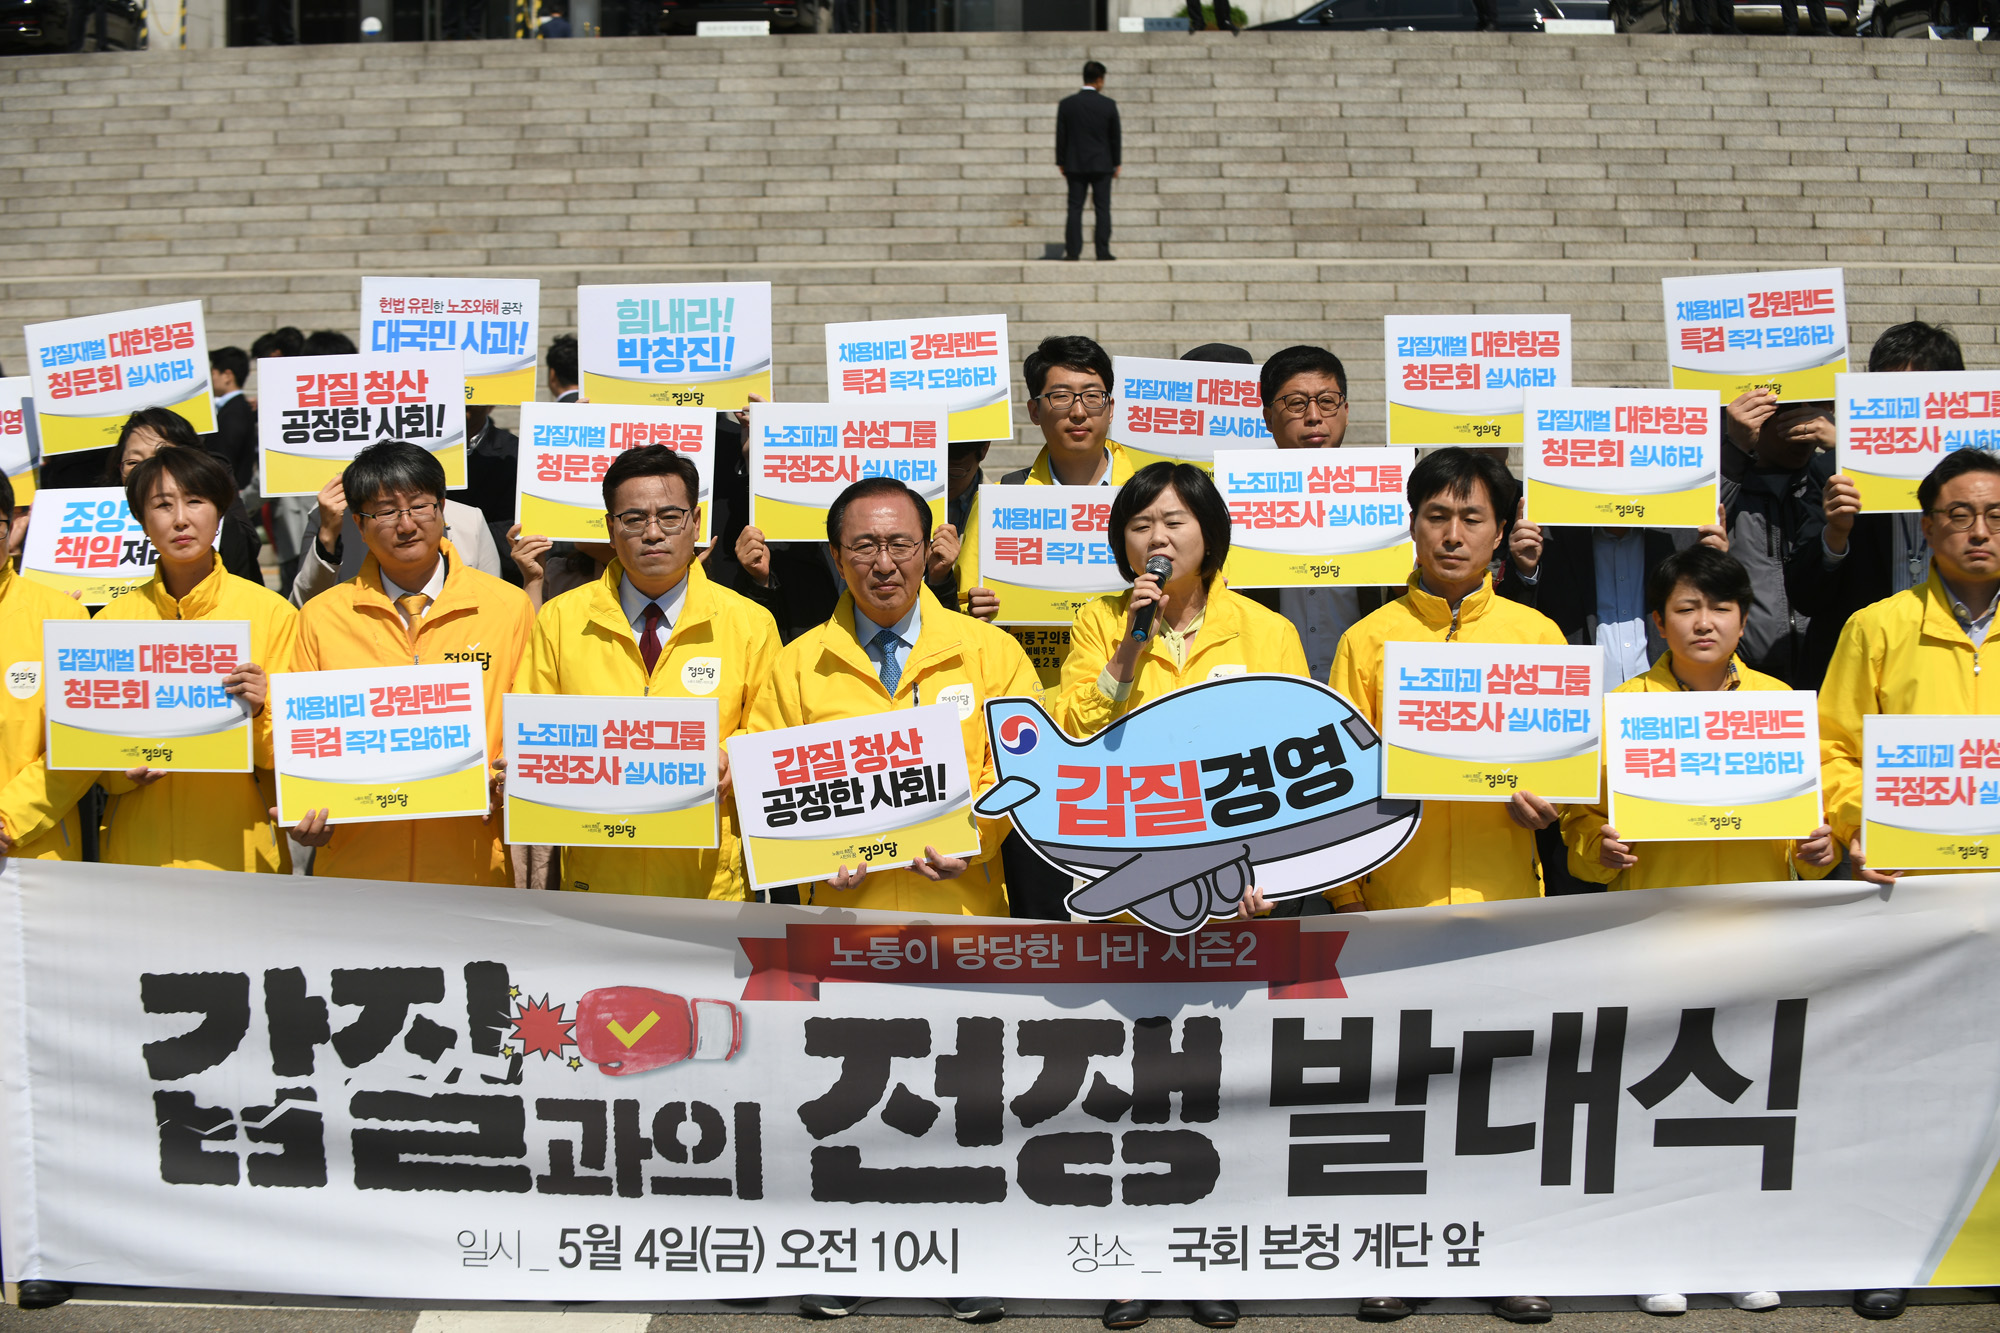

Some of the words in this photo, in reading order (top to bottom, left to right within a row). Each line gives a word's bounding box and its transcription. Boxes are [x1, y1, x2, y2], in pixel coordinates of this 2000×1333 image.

[380, 297, 404, 313] 헌법
[408, 298, 444, 315] 유린한
[448, 300, 498, 314] 노조와해
[501, 302, 523, 315] 공작
[617, 298, 734, 334] 힘내라!
[1676, 298, 1745, 321] 채용비리
[1748, 289, 1835, 318] 강원랜드
[40, 339, 107, 368] 갑질재벌
[109, 322, 194, 357] 대한항공
[372, 320, 456, 353] 대국민
[461, 321, 529, 355] 사과!
[839, 340, 907, 363] 채용비리
[911, 331, 998, 360] 강원랜드
[1397, 336, 1467, 357] 갑질재벌
[1472, 331, 1560, 357] 대한항공
[1681, 326, 1725, 353] 특검
[1728, 328, 1763, 350] 즉각
[1766, 324, 1835, 348] 도입하라
[617, 337, 735, 373] 박창진!
[48, 364, 122, 399] 청문회
[127, 358, 194, 387] 실시하라
[297, 372, 359, 408] 갑질
[364, 369, 428, 405] 청산
[843, 368, 886, 394] 특검
[890, 370, 925, 391] 즉각
[928, 366, 997, 389] 도입하라
[1403, 363, 1480, 390] 청문회
[1486, 368, 1556, 388] 실시하라
[672, 393, 705, 406] 정의당
[1124, 378, 1193, 402] 갑질재벌
[1197, 379, 1262, 407] 대한항
[0, 408, 23, 435] 영
[1128, 406, 1204, 436] 청문회
[1537, 409, 1611, 432] 갑질재벌
[1615, 406, 1708, 435] 대한항공
[1849, 397, 1920, 420] 노조파괴
[282, 407, 371, 444] 공정한
[376, 404, 445, 439] 사회!
[533, 425, 605, 448] 갑질재벌
[610, 423, 703, 452] 대한항공
[764, 425, 838, 447] 노조파괴
[843, 421, 936, 448] 삼성그룹
[1473, 425, 1501, 437] 정의당
[1542, 438, 1624, 467] 청문회
[1630, 445, 1704, 468] 실시하라
[1850, 426, 1941, 455] 국정조사
[764, 455, 860, 483] 국정조사
[862, 460, 937, 482] 실시하라
[1228, 471, 1303, 494] 노조파괴
[1308, 465, 1403, 493] 삼성그룹
[993, 508, 1067, 530] 채용비리
[1229, 500, 1326, 529] 국정조사
[1329, 504, 1404, 526] 실시하라
[1615, 505, 1645, 518] 정의당
[995, 537, 1042, 565] 특검
[1047, 542, 1085, 564] 즉각
[1310, 565, 1341, 578] 정의당
[58, 648, 135, 672] 갑질재벌
[139, 644, 238, 674] 대한항공
[688, 667, 715, 679] 정의당
[11, 672, 36, 684] 정의당
[1400, 667, 1482, 693] 노조파괴
[1487, 664, 1591, 696] 삼성그룹
[64, 679, 149, 709] 청문회
[155, 685, 233, 708] 실시하라
[286, 693, 365, 720] 채용비리
[370, 683, 472, 717] 강원랜드
[1398, 700, 1505, 732] 국정조사
[1508, 708, 1591, 733] 실시하라
[1621, 716, 1700, 740] 채용비리
[1705, 710, 1805, 740] 강원랜드
[291, 727, 342, 758] 특검
[346, 729, 387, 754] 즉각
[390, 724, 471, 752] 도입하라
[518, 723, 598, 748] 노조파괴
[603, 720, 706, 750] 삼성그룹
[142, 748, 173, 761] 정의당
[773, 740, 846, 786] 갑질
[849, 728, 923, 774] 청산
[1625, 748, 1676, 778] 특검
[1680, 752, 1721, 776] 즉각
[1725, 751, 1804, 775] 도입하라
[1876, 744, 1954, 768] 노조파괴
[1960, 739, 2000, 769] 삼성
[518, 754, 622, 785] 국정조사
[624, 762, 706, 786] 실시하라
[1057, 722, 1355, 840] 갑질경영
[1484, 774, 1519, 788] 정의당
[376, 794, 408, 808] 정의당
[762, 777, 864, 827] 공정한
[871, 764, 945, 810] 사회!
[1876, 776, 1976, 807] 국정조사
[603, 824, 637, 838] 정의당
[1710, 816, 1742, 830] 정의당
[858, 841, 898, 861] 정의당
[1958, 846, 1989, 859] 정의당
[830, 935, 939, 970] 노동이
[953, 934, 1063, 970] 당당한
[1078, 934, 1151, 969] 나라
[1161, 931, 1258, 968] 시즌2
[797, 1015, 1223, 1207] 전쟁
[1270, 998, 1809, 1197] 발대식
[559, 1224, 621, 1270] 5월
[635, 1226, 764, 1273] 4일(금)
[777, 1228, 856, 1272] 오전
[872, 1229, 958, 1273] 10시
[1169, 1225, 1247, 1271] 국회
[1260, 1224, 1339, 1270] 본청
[1353, 1223, 1432, 1268] 계단
[1443, 1222, 1484, 1266] 앞
